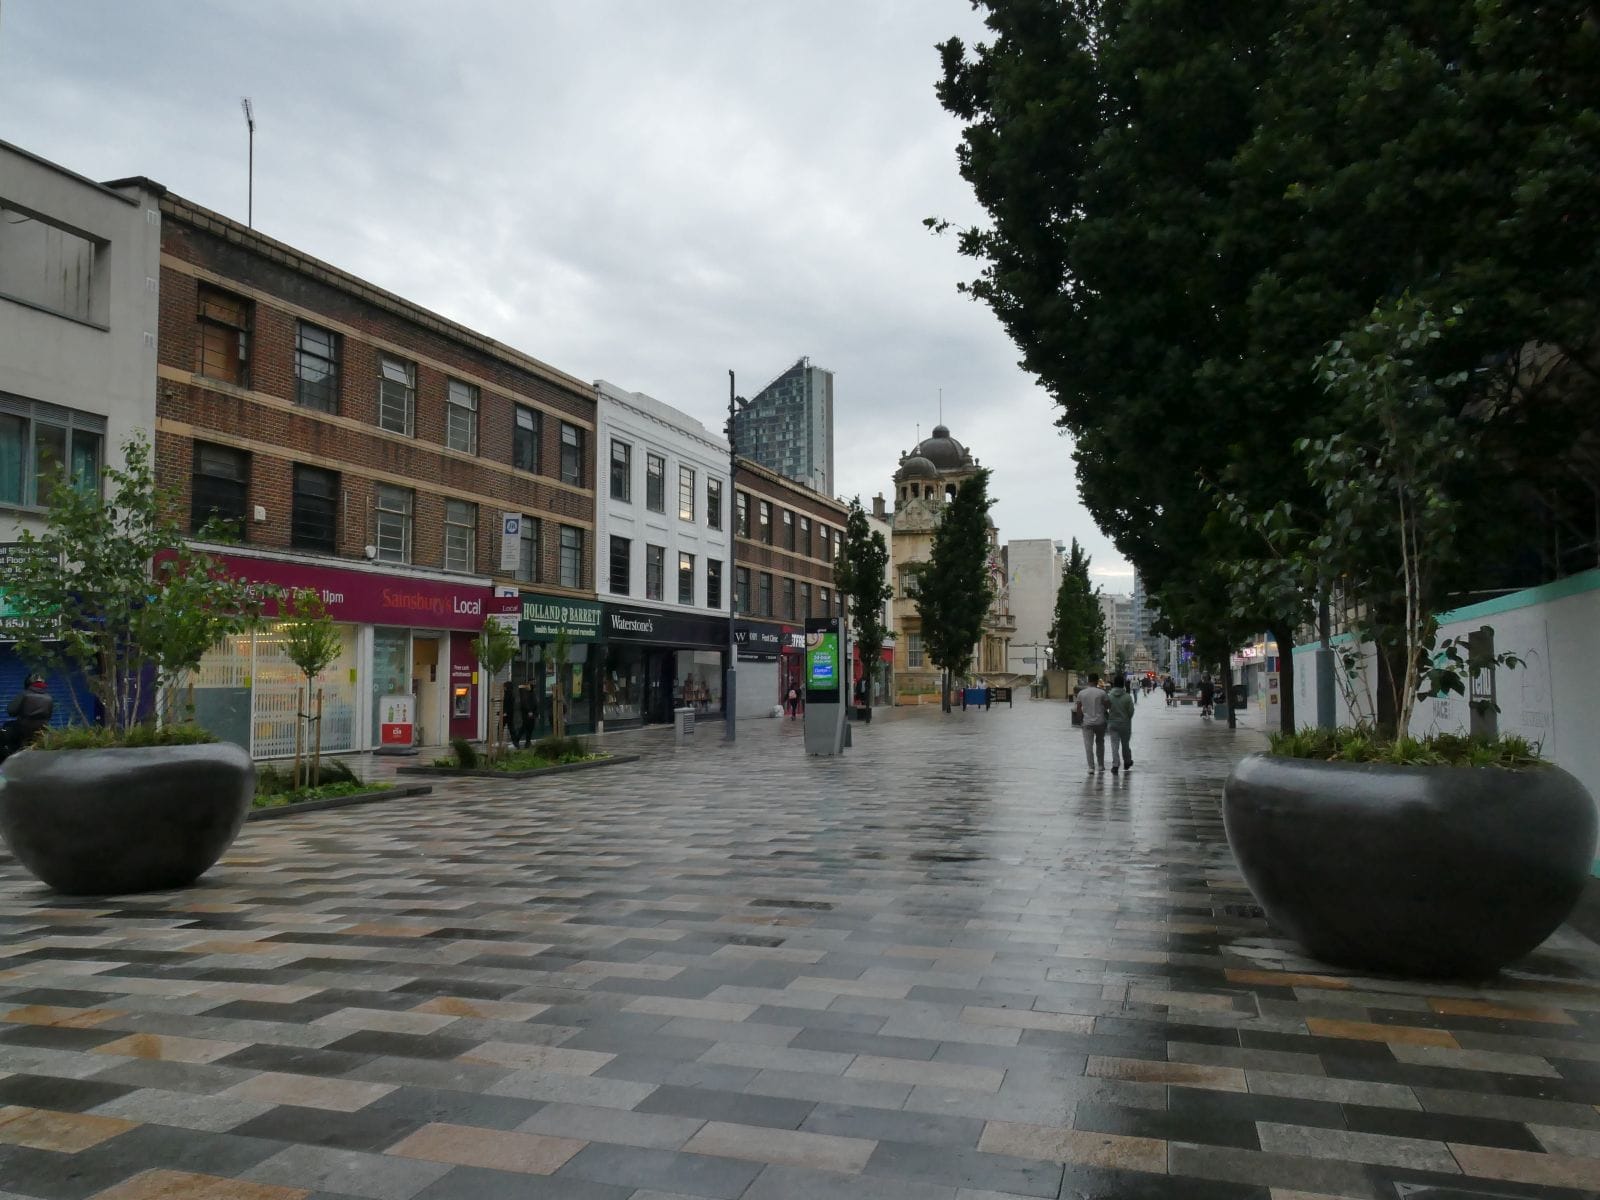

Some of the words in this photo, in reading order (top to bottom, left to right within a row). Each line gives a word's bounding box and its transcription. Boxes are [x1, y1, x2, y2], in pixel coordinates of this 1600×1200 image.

[383, 588, 451, 615] Sainsbury's
[453, 595, 482, 615] Local
[502, 604, 519, 613] Local
[523, 603, 560, 620] HOLLAND
[561, 606, 568, 623] &
[569, 607, 601, 625] BARRETT
[611, 614, 653, 633] Waterstone's
[735, 632, 746, 642] W
